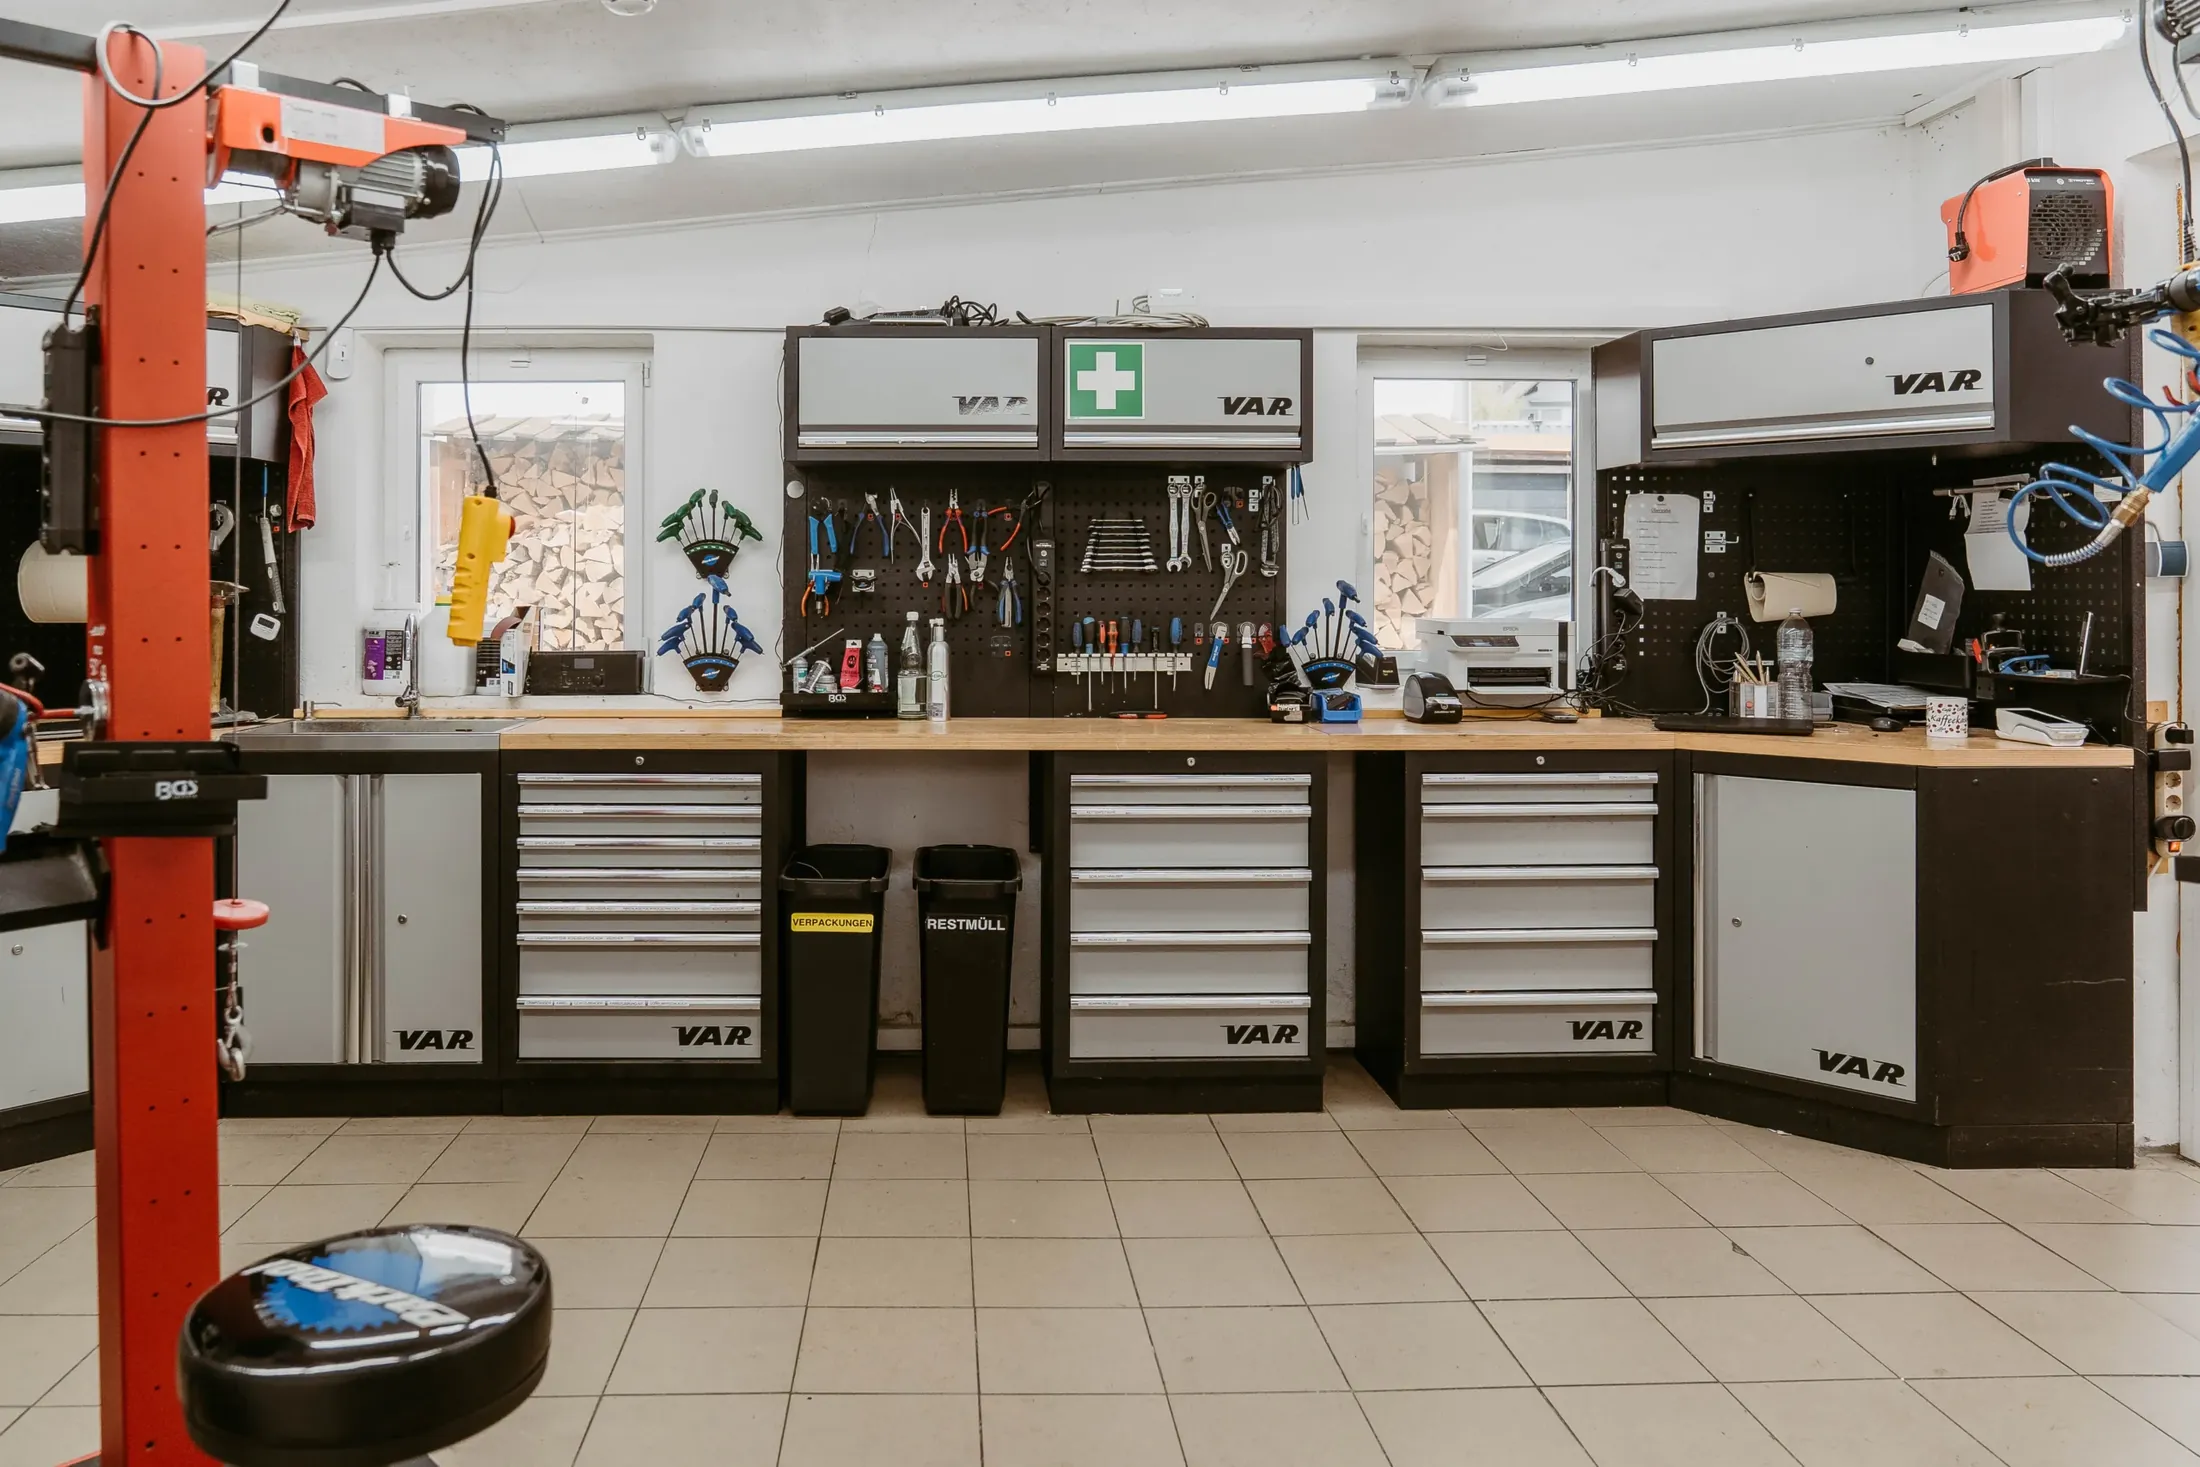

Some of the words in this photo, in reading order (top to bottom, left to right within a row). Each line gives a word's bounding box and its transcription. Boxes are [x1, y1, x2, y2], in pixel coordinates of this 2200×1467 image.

[1885, 369, 1983, 395] VAR
[952, 395, 1030, 416] VAR
[1217, 396, 1294, 416] VAR
[828, 694, 847, 703] BGS
[155, 780, 198, 801] BGS
[792, 918, 873, 928] VERPACKUNGEN
[927, 917, 1005, 931] RESTMÜLL
[392, 1030, 475, 1050] VAR
[671, 1026, 753, 1046] VAR
[1220, 1024, 1300, 1045] VAR
[1566, 1020, 1644, 1040] VAR
[1811, 1048, 1907, 1087] VAR
